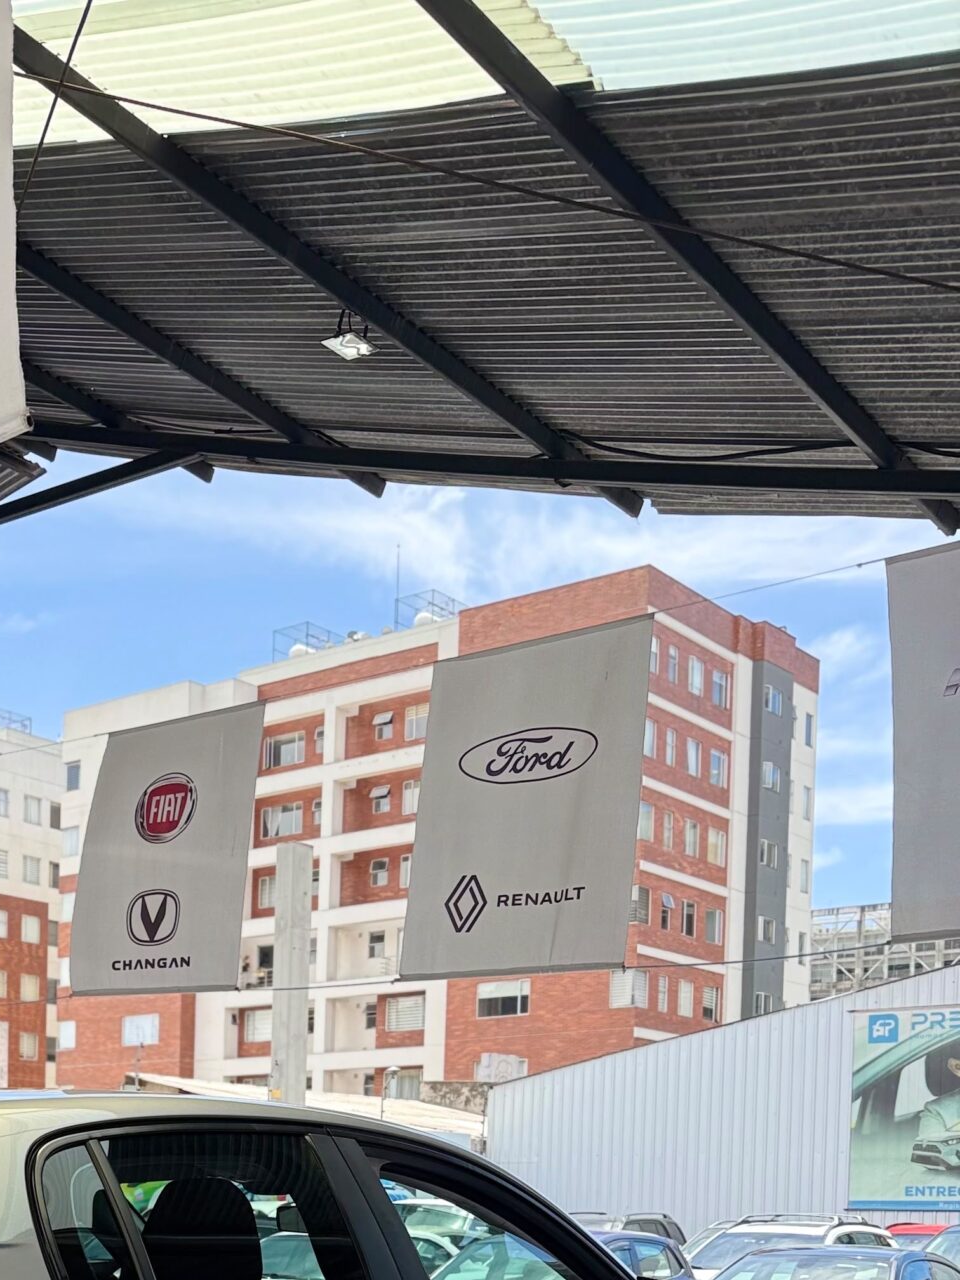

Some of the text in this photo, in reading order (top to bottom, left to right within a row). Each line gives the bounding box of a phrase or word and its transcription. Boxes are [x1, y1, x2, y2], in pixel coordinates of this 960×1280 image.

[486, 735, 575, 776] Ford
[149, 792, 186, 825] FIAT
[496, 886, 586, 907] RENAULT
[111, 956, 191, 971] CHANGAN
[904, 1185, 960, 1197] ENTRE
